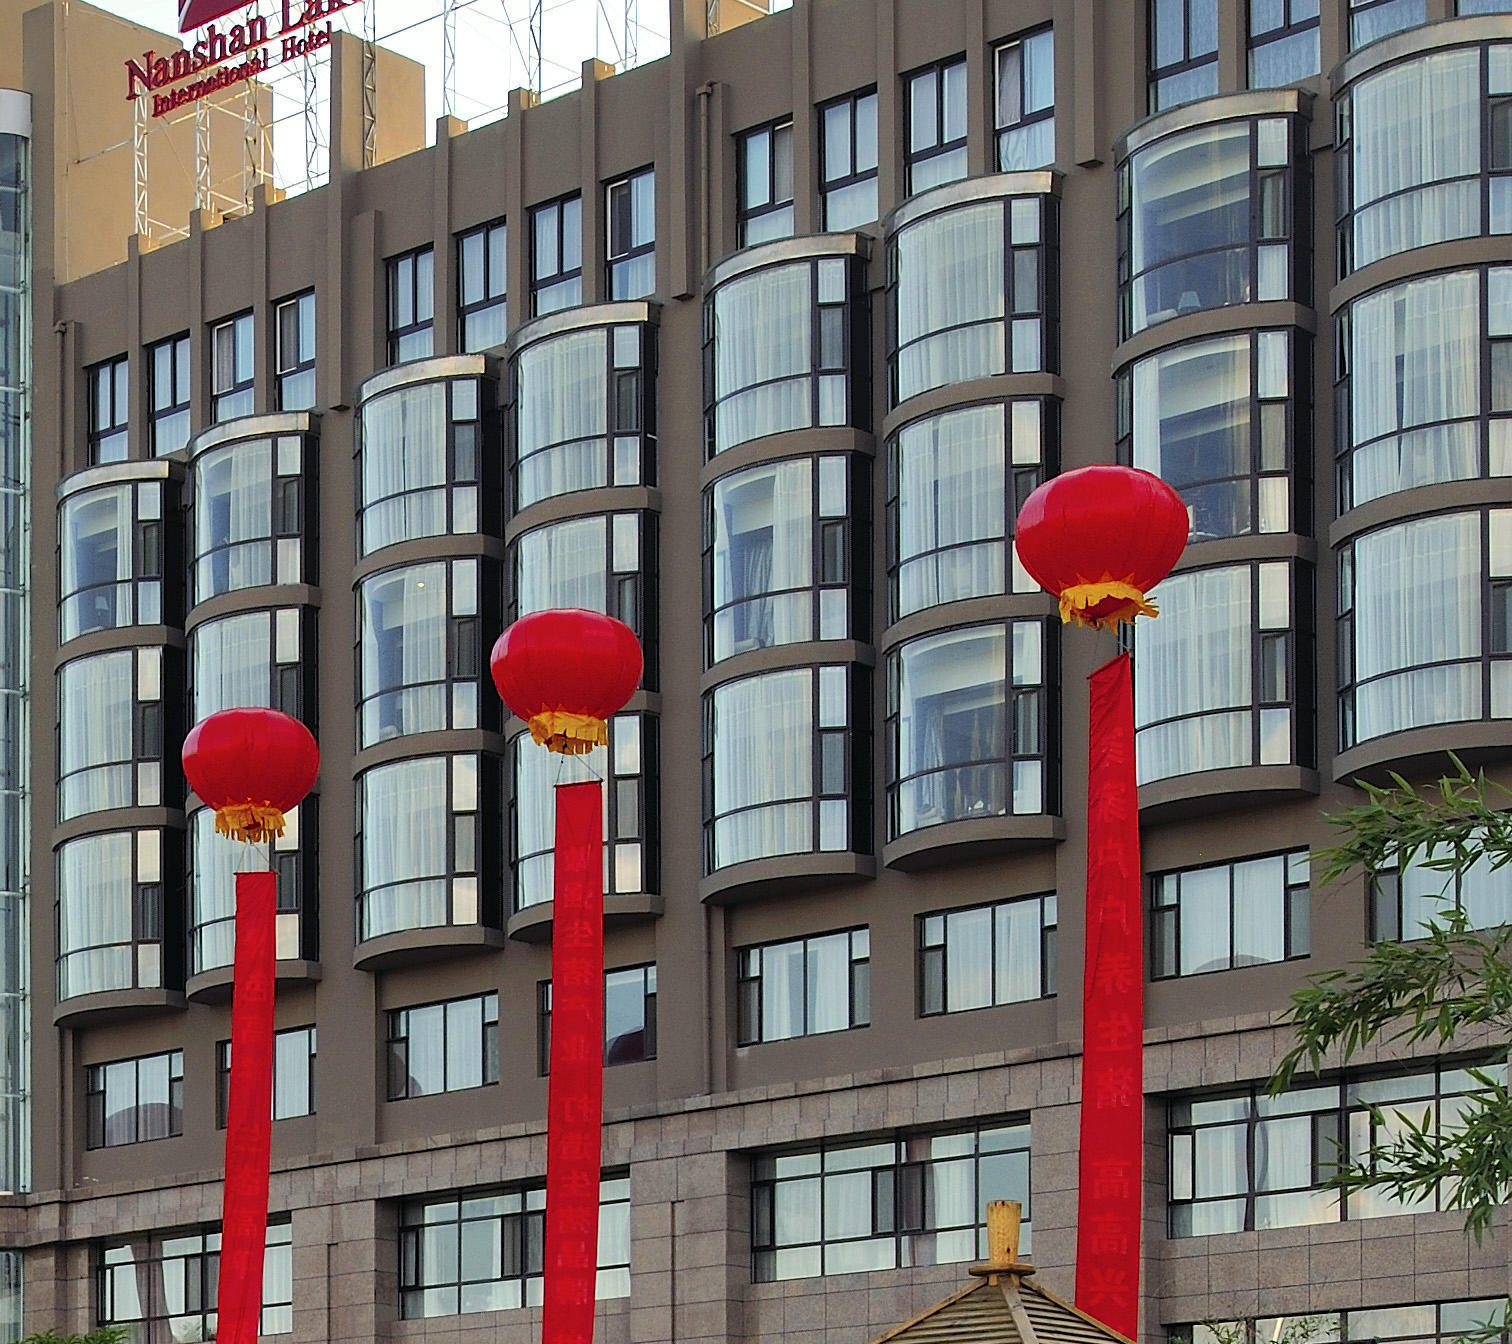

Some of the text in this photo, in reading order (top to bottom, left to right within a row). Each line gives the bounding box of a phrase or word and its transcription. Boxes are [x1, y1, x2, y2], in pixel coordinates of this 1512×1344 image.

[124, 14, 268, 101] Nanshan
[151, 20, 333, 118] International Hotel
